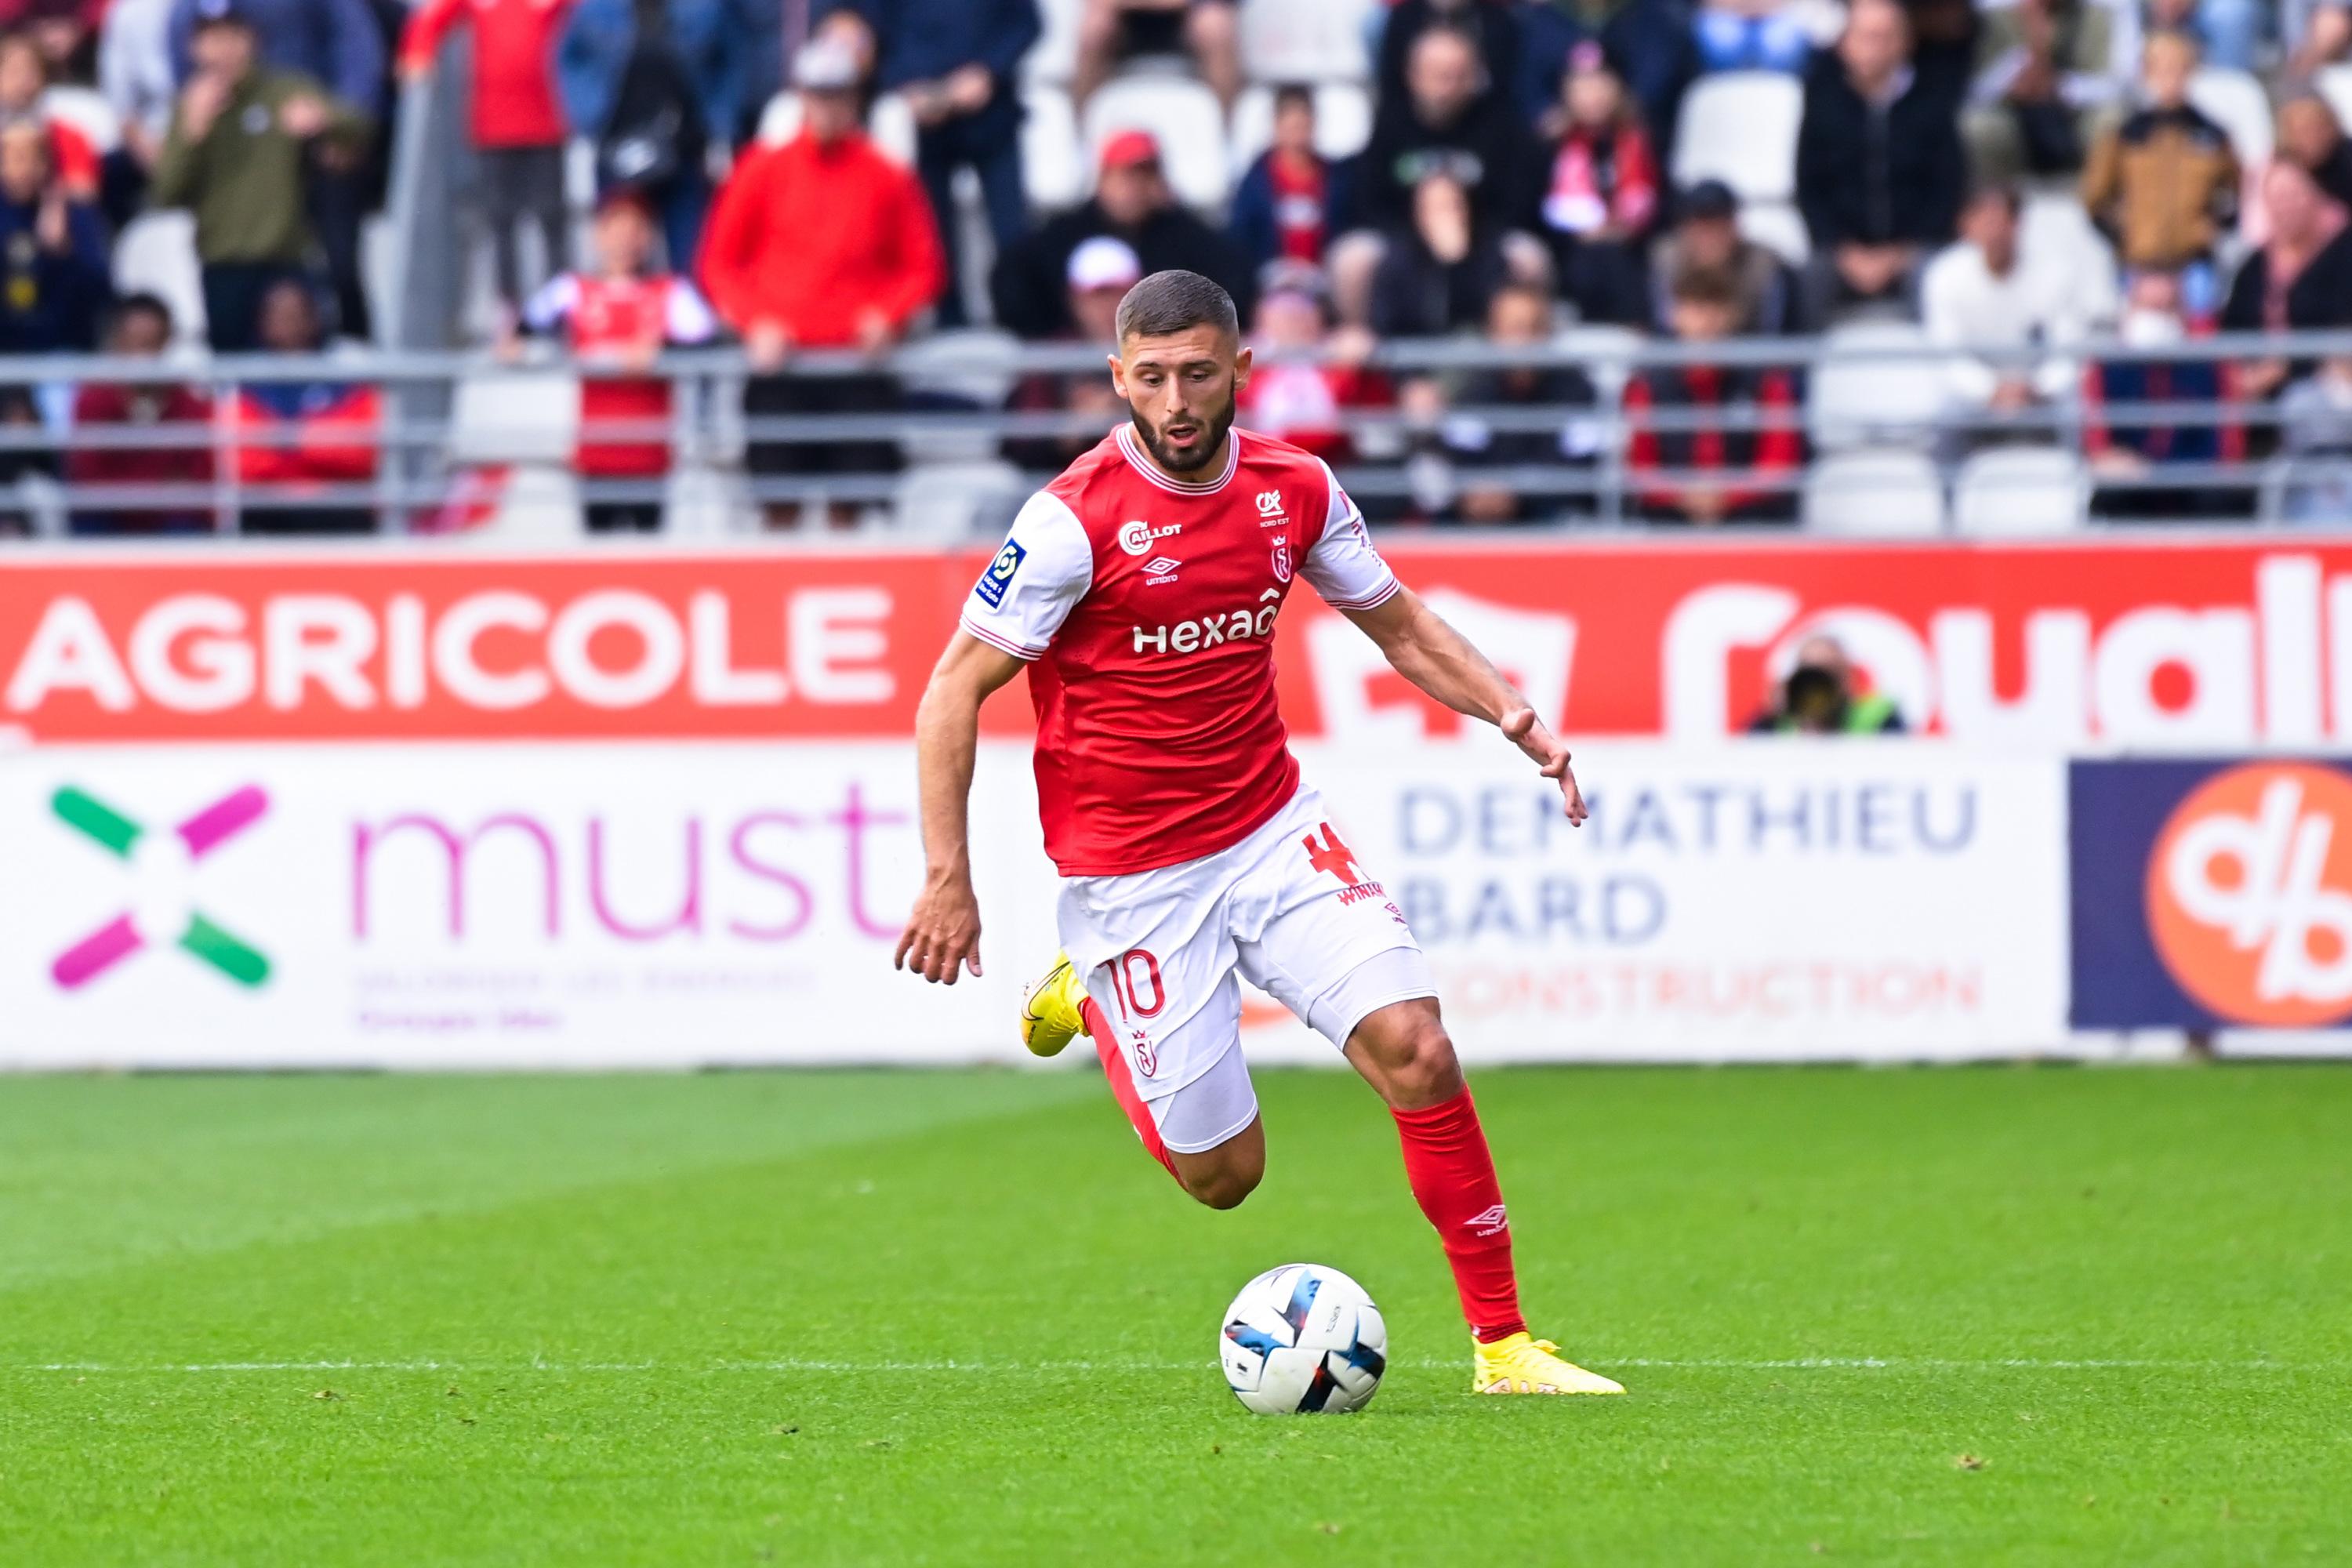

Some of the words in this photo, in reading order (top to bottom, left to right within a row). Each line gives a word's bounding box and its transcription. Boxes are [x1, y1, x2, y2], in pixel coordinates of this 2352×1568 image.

[1259, 519, 1277, 528] NORD
[1277, 517, 1290, 526] EST
[1145, 574, 1178, 586] umbro
[4, 586, 895, 713] AGRICOLE
[1399, 786, 1977, 856] DEMATHIEU
[352, 779, 911, 942] must
[1402, 874, 1665, 942] BARD
[1097, 949, 1166, 1023] 10
[1433, 961, 1984, 1018] ONSTRUCTION
